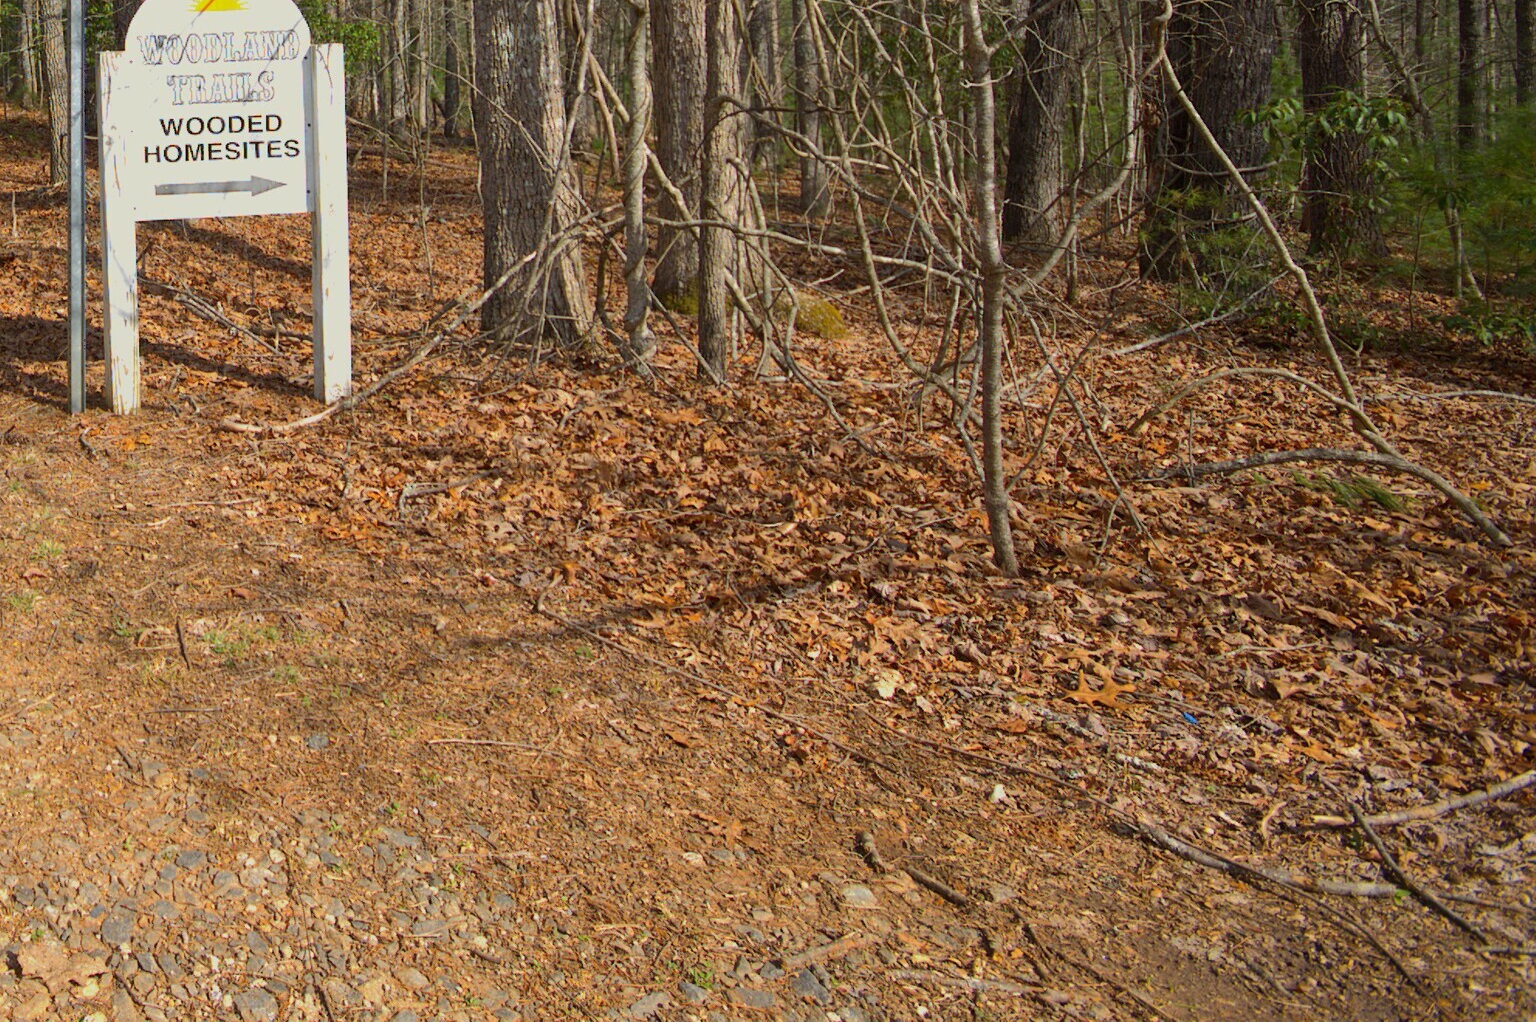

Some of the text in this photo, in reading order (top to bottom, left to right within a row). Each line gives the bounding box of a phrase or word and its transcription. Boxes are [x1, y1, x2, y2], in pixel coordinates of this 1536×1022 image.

[137, 29, 301, 65] WOODLAND
[167, 71, 275, 105] TRAILS
[159, 114, 282, 136] WOODED
[144, 139, 300, 163] HOMESITES
